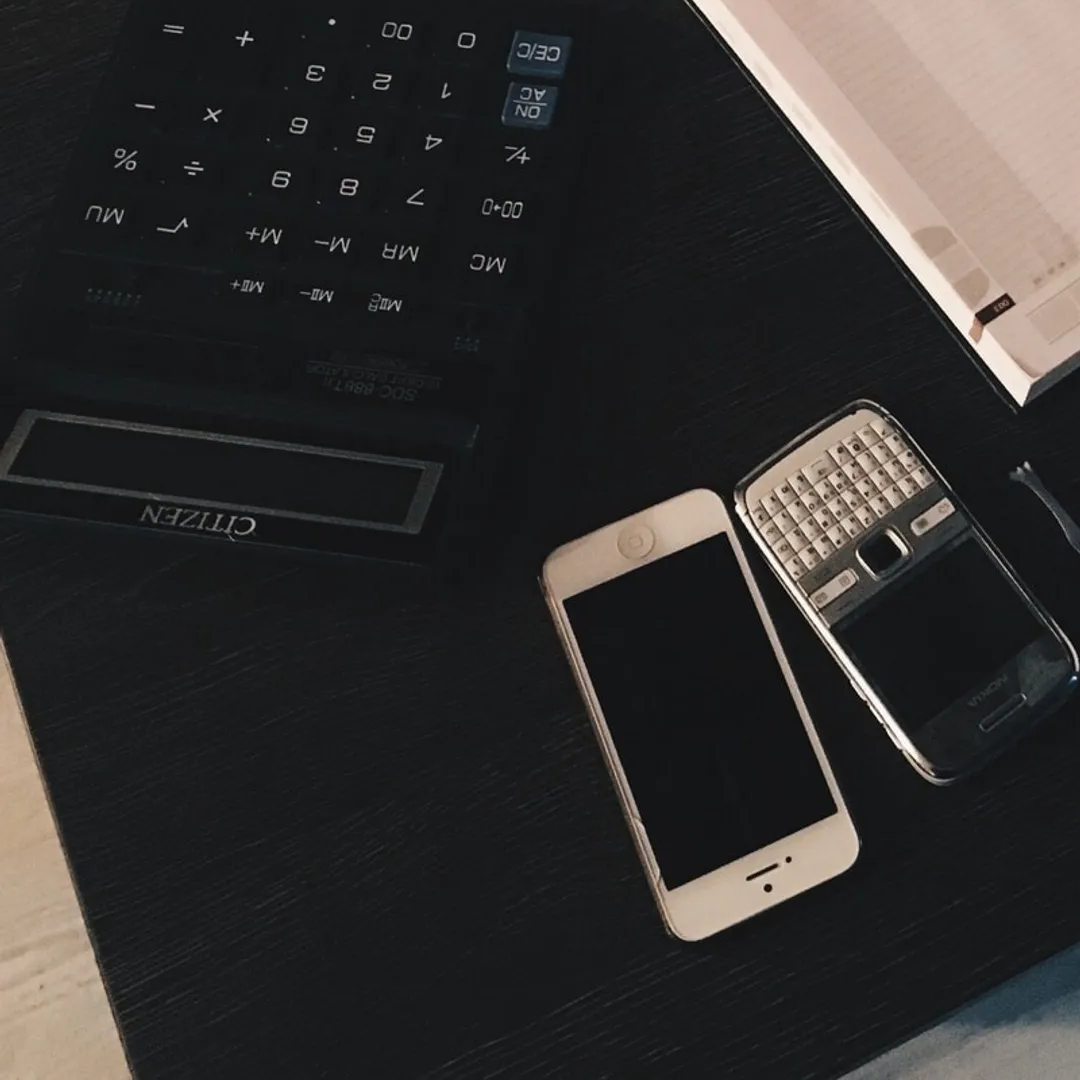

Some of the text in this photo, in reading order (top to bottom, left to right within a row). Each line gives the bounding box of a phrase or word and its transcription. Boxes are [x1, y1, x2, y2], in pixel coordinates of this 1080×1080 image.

[381, 21, 413, 41] 00
[457, 32, 477, 49] 0
[517, 42, 561, 62] CE/C
[305, 64, 326, 82] 3
[372, 73, 393, 91] 2
[441, 82, 452, 99] 1
[516, 87, 547, 103] AC
[515, 101, 544, 119] ON
[289, 117, 309, 135] 6
[356, 125, 376, 144] 5
[424, 134, 443, 151] 4
[271, 170, 292, 188] 9
[339, 178, 360, 196] 8
[406, 188, 425, 206] 7
[86, 205, 125, 225] MU
[246, 227, 283, 245] M+
[381, 243, 420, 262] MR
[469, 253, 507, 274] MC
[140, 504, 257, 537] CITIZEN
